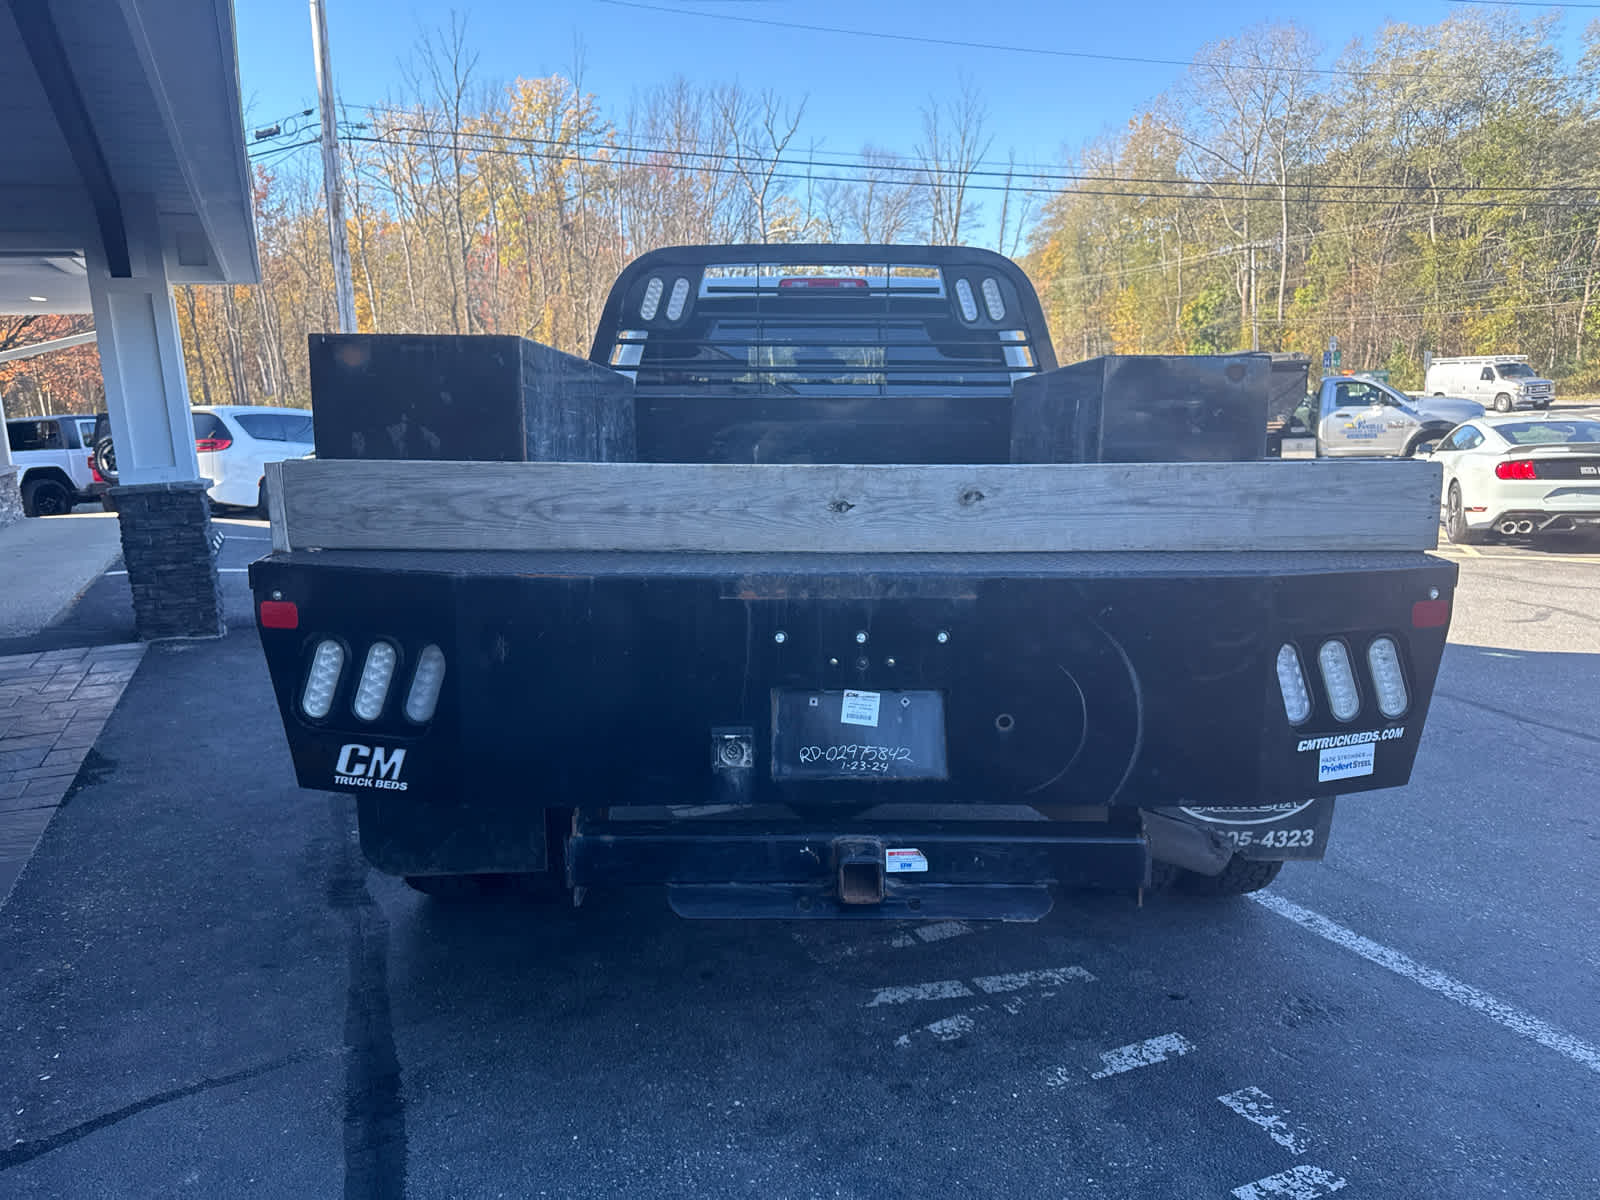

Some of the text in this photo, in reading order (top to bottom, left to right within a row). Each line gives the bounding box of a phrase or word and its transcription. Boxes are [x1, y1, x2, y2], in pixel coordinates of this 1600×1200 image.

[1297, 727, 1405, 752] CMTRUCKBEDS.COM
[335, 744, 407, 780] CM
[841, 760, 889, 772] 1-23-24
[334, 775, 408, 791] TRUCK BEDS
